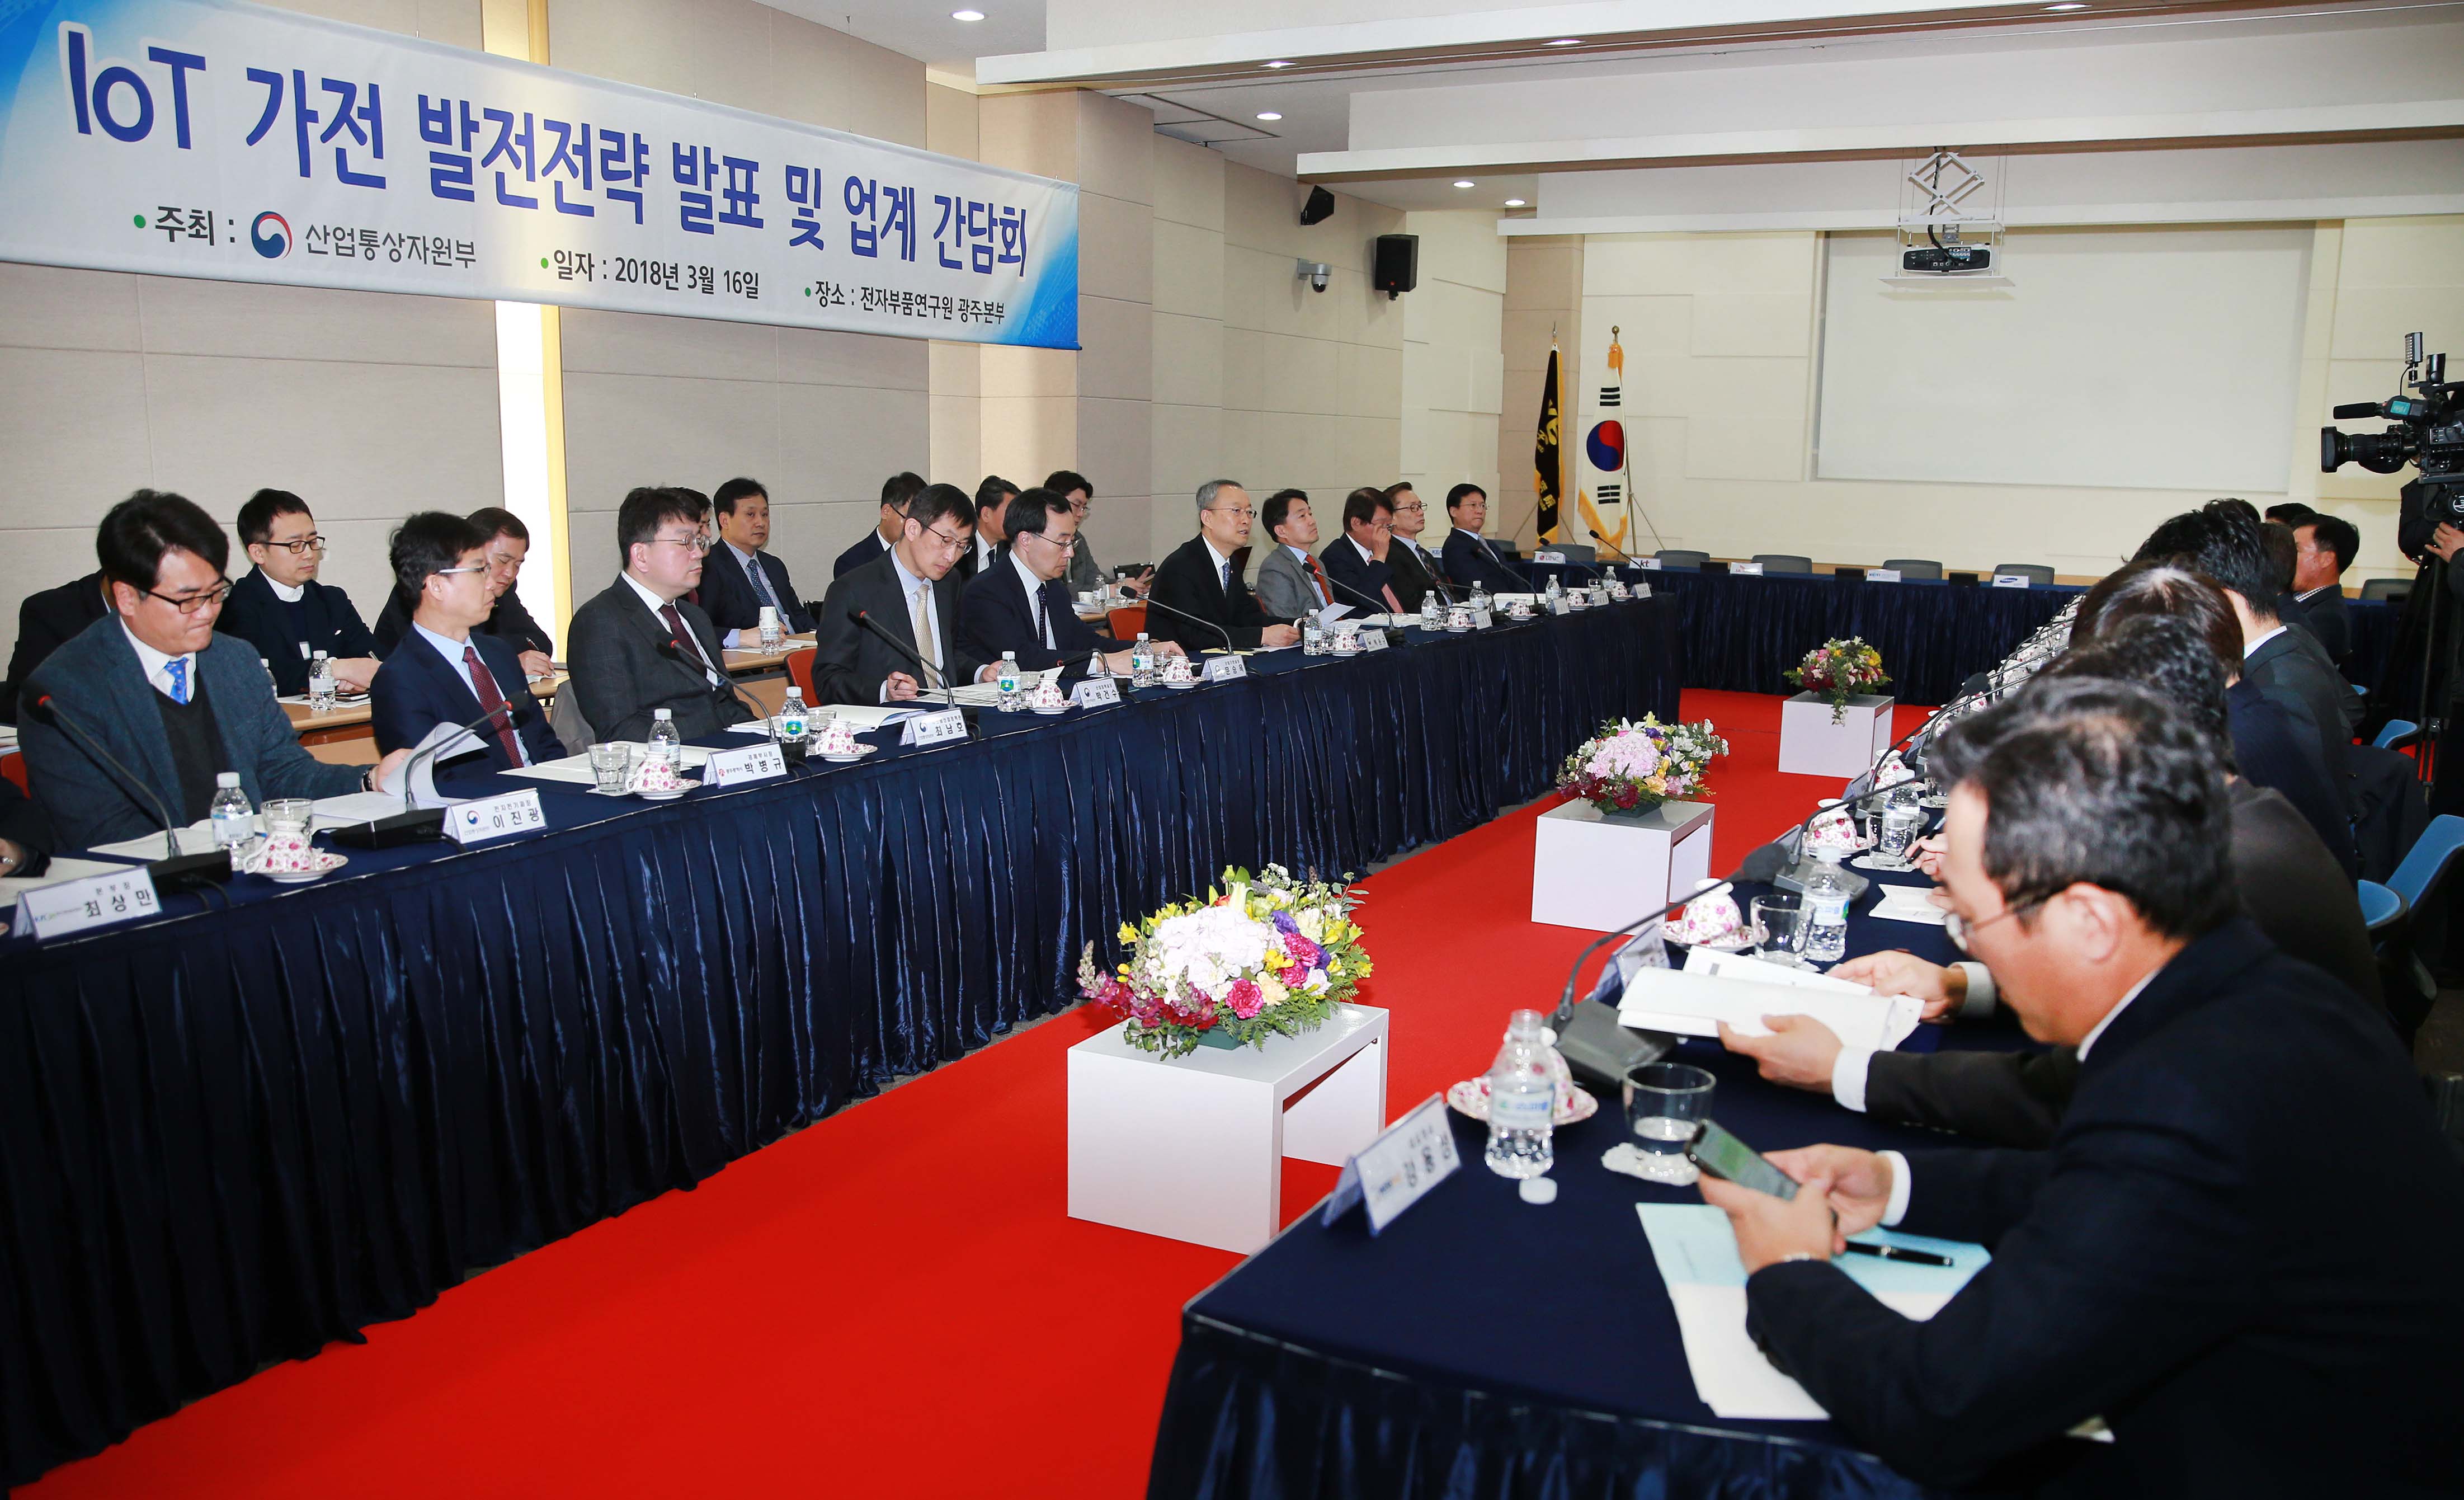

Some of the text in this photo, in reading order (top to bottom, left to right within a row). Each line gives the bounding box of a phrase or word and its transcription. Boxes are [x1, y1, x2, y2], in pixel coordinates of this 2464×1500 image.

[68, 31, 1027, 278] IoT 가전 발전전략 발표 및 업계 간담회
[155, 205, 215, 246] 주최
[305, 224, 477, 269] 산업통상자원부
[553, 249, 595, 283] 일자
[614, 256, 680, 292] 2018년
[687, 263, 714, 294] 3월
[724, 270, 759, 299] 16일
[815, 280, 846, 308] 장소
[860, 286, 953, 321] 전자부품연구원
[957, 296, 1005, 325] 광주본부
